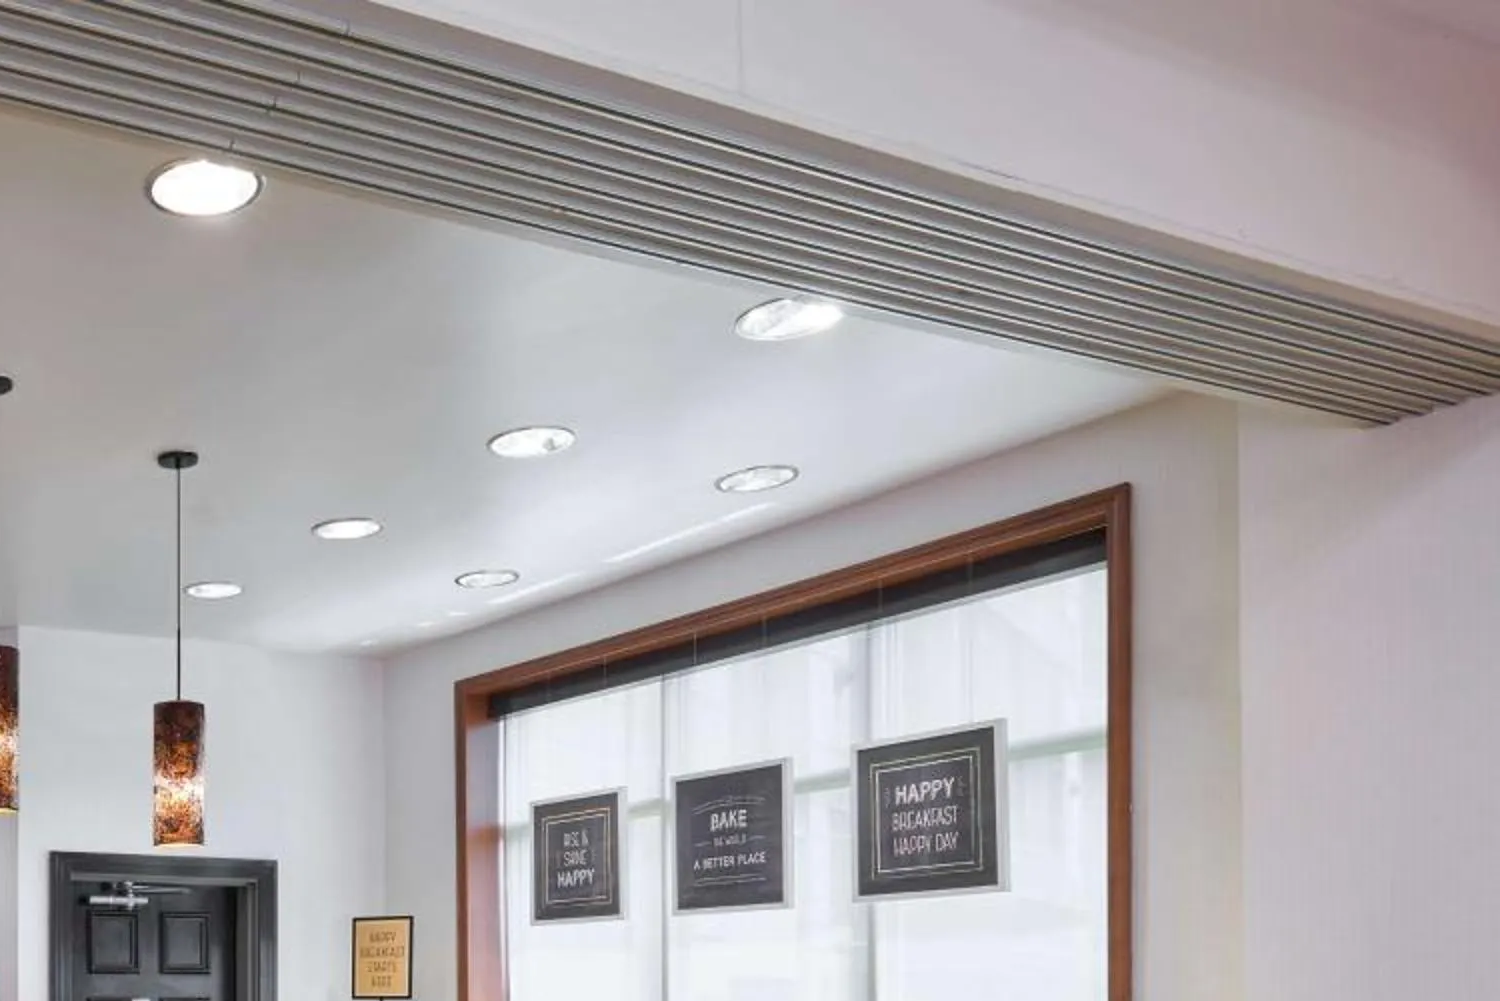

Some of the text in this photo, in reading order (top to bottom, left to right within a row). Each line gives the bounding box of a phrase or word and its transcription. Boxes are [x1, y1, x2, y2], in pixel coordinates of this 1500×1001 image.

[895, 776, 955, 806] HAPPY
[710, 809, 747, 832] BAKE
[891, 804, 958, 832] BREAKFAST
[935, 831, 959, 852] DAY
[737, 851, 766, 865] PLACE
[557, 867, 595, 889] HAPPY
